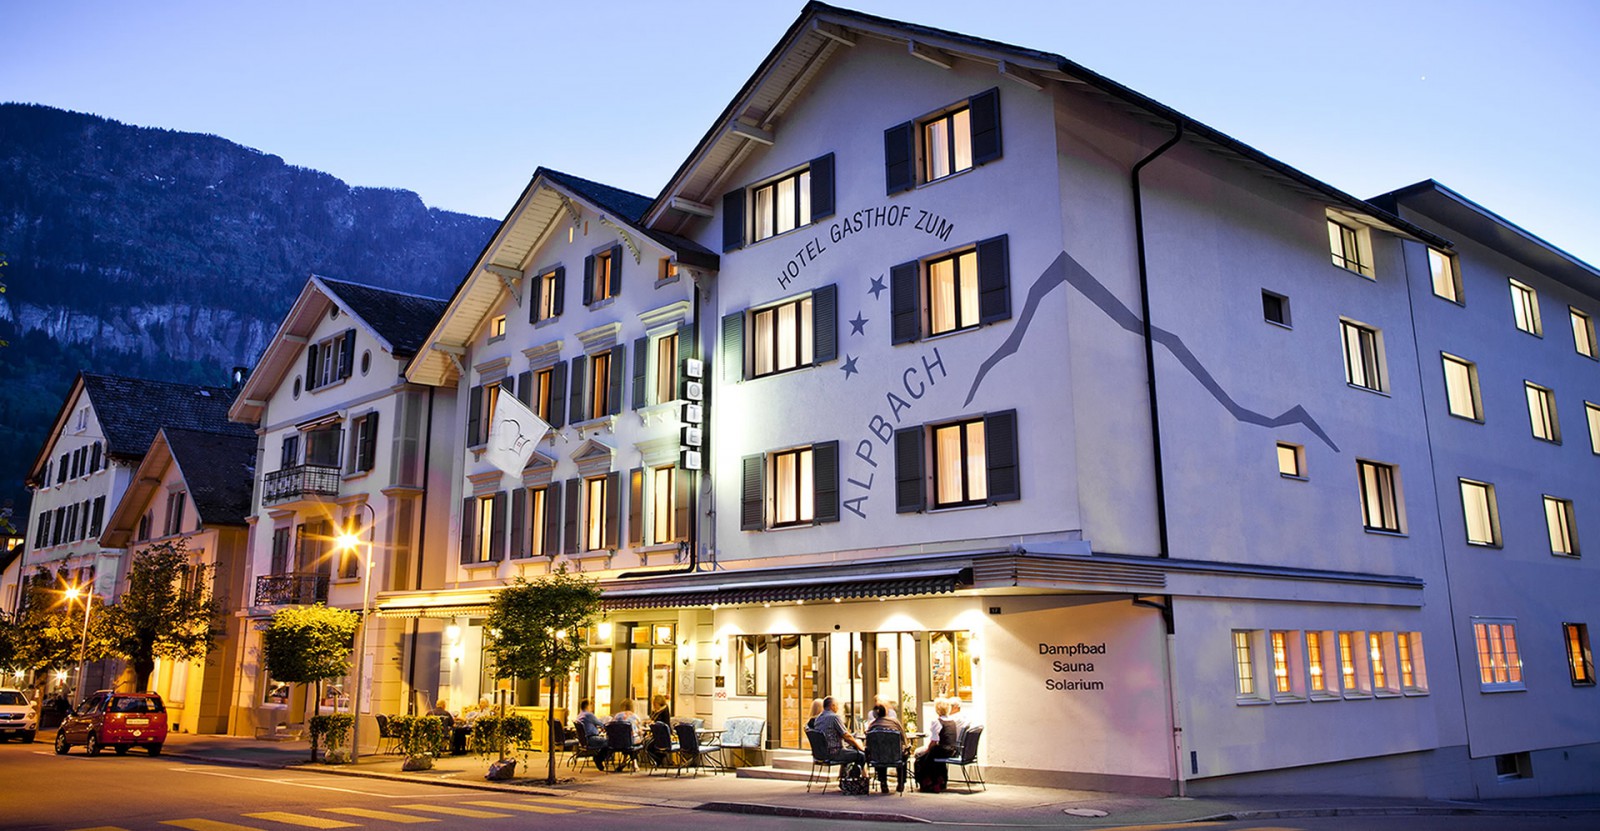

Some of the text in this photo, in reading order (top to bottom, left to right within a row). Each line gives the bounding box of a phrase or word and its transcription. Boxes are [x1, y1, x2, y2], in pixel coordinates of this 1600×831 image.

[777, 205, 954, 290] HOTEL GASTHOF ZUM
[689, 362, 701, 467] HOTEL
[843, 347, 948, 519] ALPBACH
[1039, 643, 1106, 657] Dampfbad
[1053, 661, 1094, 672] Sauna
[1045, 679, 1104, 690] Solarium
